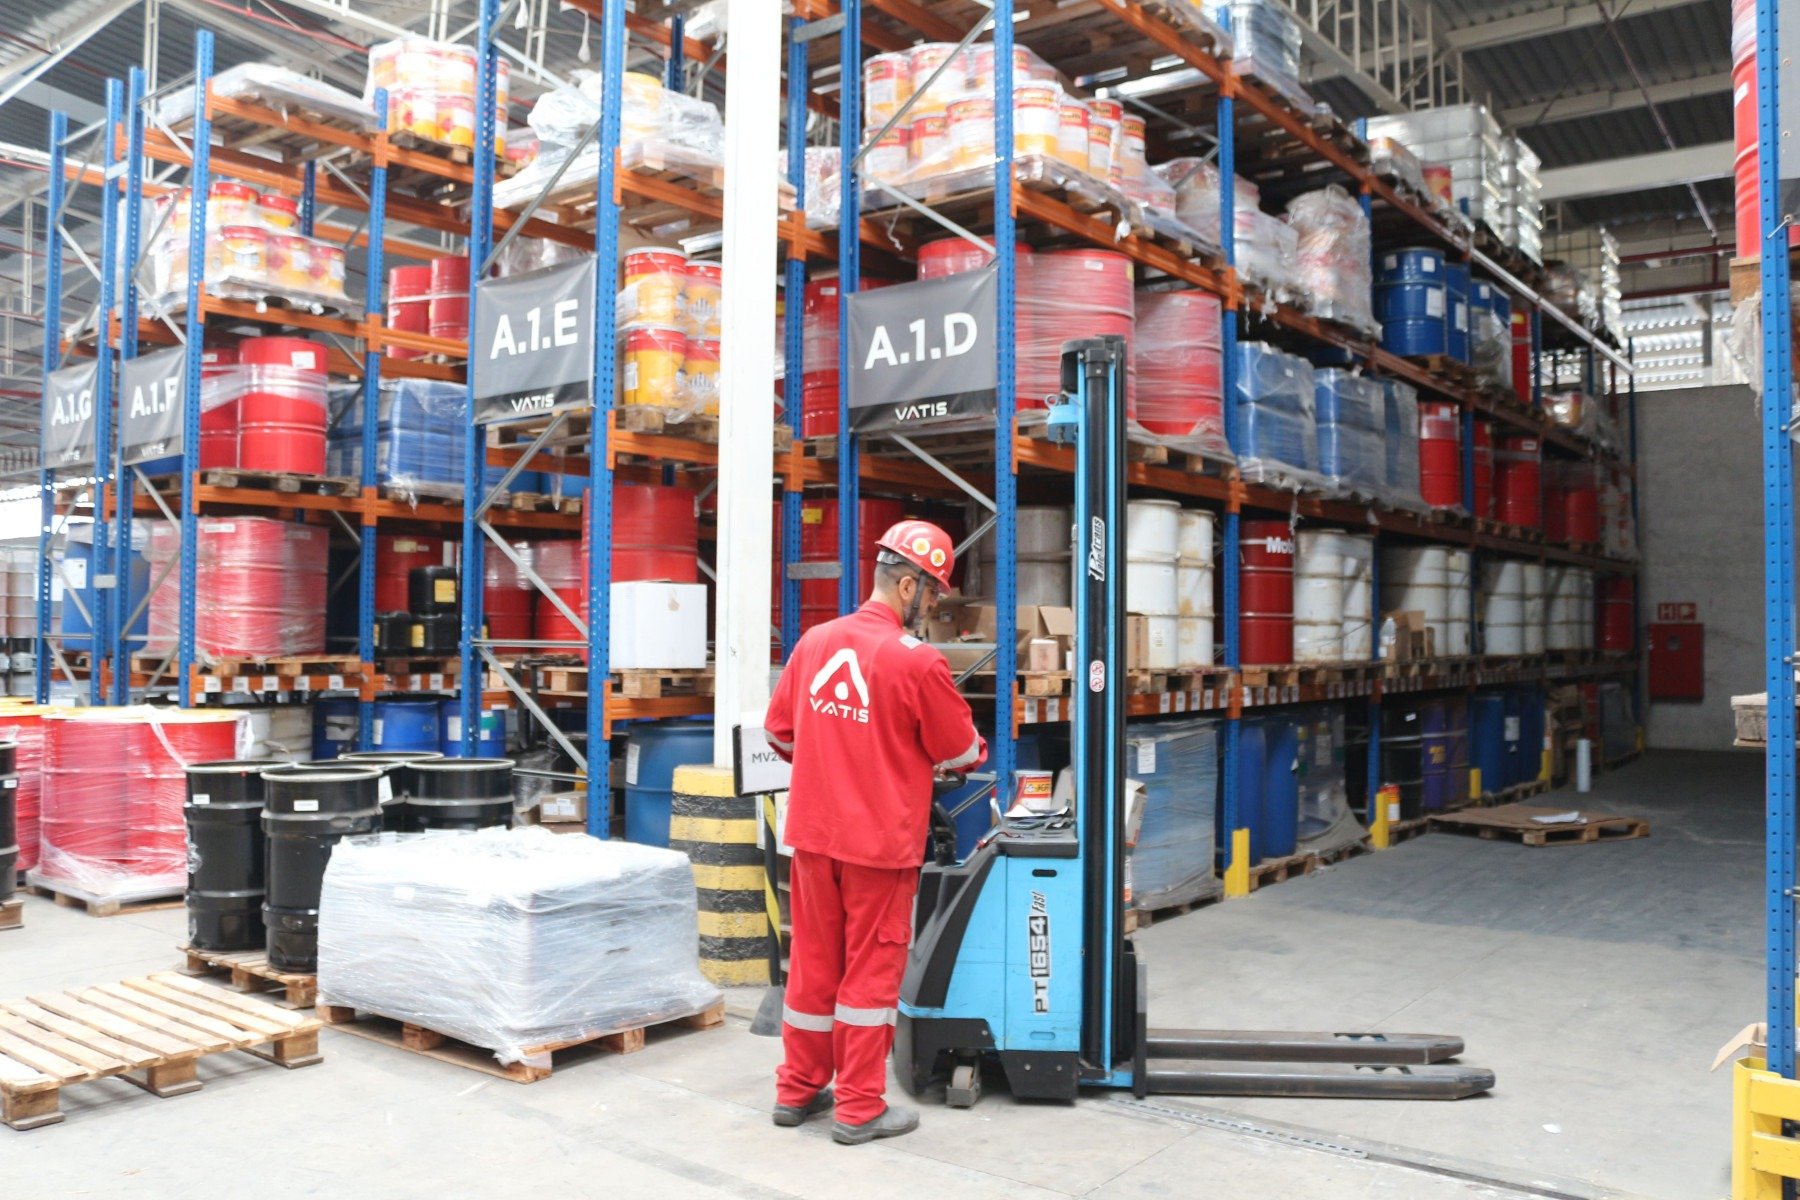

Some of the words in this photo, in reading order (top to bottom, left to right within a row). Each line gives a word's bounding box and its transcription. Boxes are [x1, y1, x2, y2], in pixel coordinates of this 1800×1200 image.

[490, 299, 578, 360] A.1.E
[864, 312, 978, 370] A.1.D
[51, 389, 92, 426] A.1.G
[130, 376, 179, 419] A.1.F
[511, 393, 555, 412] VATIS
[895, 401, 948, 421] VATIS
[809, 697, 869, 724] VATIS
[752, 751, 783, 763] MV2
[1030, 916, 1049, 977] 1654
